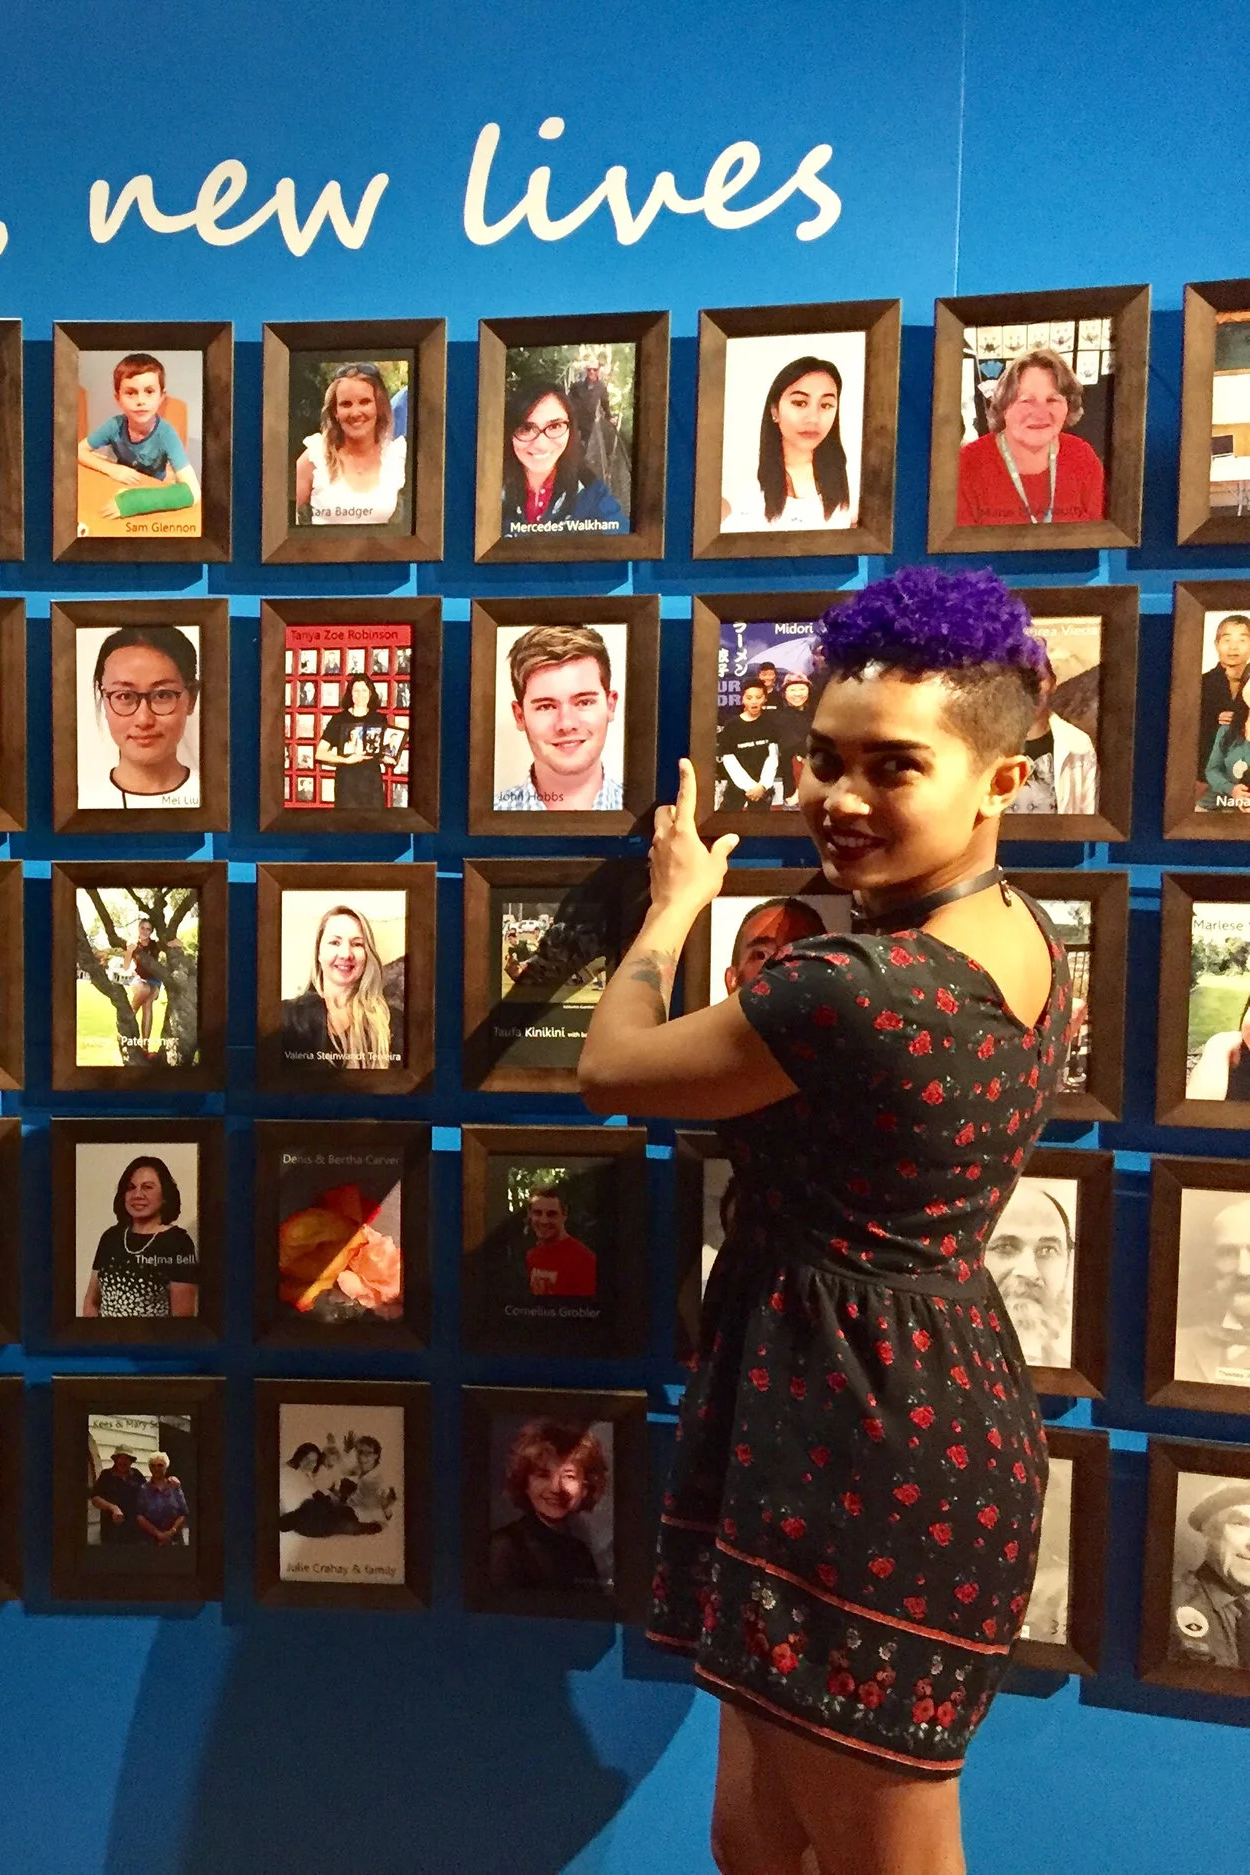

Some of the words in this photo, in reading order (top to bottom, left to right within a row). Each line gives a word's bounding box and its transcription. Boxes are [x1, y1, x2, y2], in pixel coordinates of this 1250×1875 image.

[89, 158, 390, 258] new
[462, 116, 842, 247] lives
[309, 506, 332, 517] ara
[335, 506, 373, 519] Badger
[125, 522, 148, 533] Sam
[151, 522, 197, 533] Glennon
[510, 520, 564, 533] Mercedes
[566, 519, 620, 531] Walkham
[774, 622, 814, 636] Midori
[291, 630, 321, 643] Tanya
[324, 629, 345, 641] Zoe
[348, 629, 399, 641] Robinson
[528, 791, 564, 802] Hobbs
[524, 1026, 566, 1038] Kinikini
[121, 1036, 166, 1047] Patern
[282, 1153, 312, 1165] Denis
[315, 1154, 325, 1165] &
[328, 1154, 363, 1165] Bertha
[135, 1254, 173, 1265] Thelma
[176, 1254, 195, 1265] Bell
